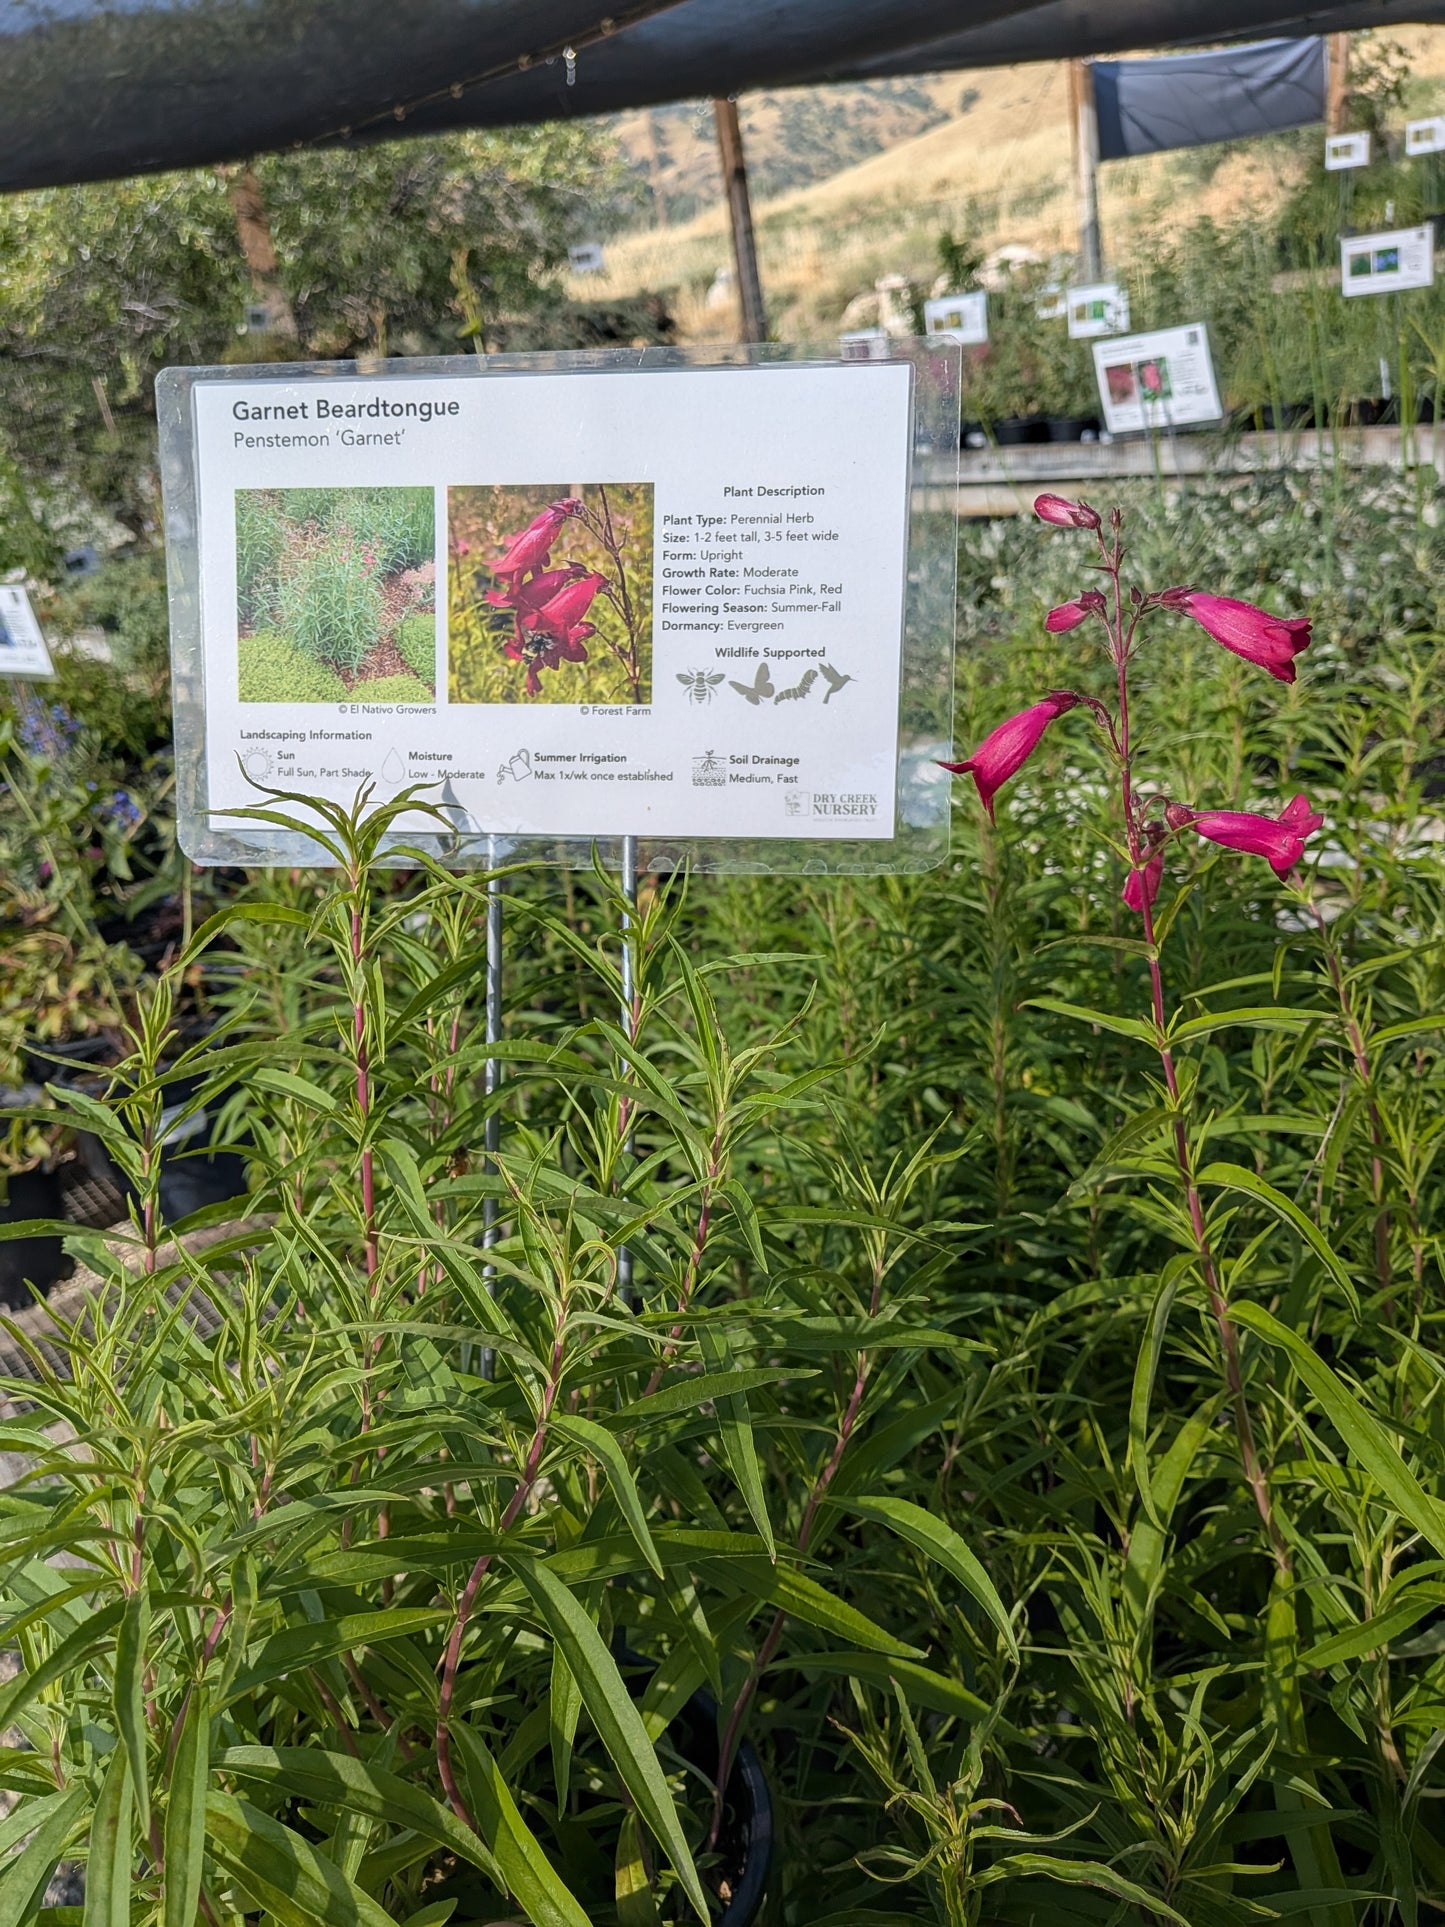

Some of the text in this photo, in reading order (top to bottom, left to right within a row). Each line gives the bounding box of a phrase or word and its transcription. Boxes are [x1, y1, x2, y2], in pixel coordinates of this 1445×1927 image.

[233, 397, 460, 422] Garnet Beardtongue
[234, 432, 329, 448] Penstemon
[724, 485, 825, 498] Plant Description
[663, 512, 814, 527] Plant Type: Perennial Herb
[662, 530, 839, 543] Size: 1-2 feet tall, 3-5 feet wide
[662, 550, 743, 563] Form: Upright
[662, 567, 798, 578] Growth Rate: Moderate
[662, 584, 842, 595] Flower Color: Fuchsia Pink, Red
[662, 601, 841, 615] Flowering Season: Summer-Fall
[662, 620, 784, 633] Dormancy: Evergreen
[715, 647, 825, 660] Wildlife Supported
[350, 705, 359, 714] El
[362, 705, 393, 714] Nativo
[396, 705, 436, 714] Growers
[592, 706, 622, 716] Forest
[626, 706, 651, 715] Farm
[240, 730, 372, 742] Landscaping Information
[277, 751, 295, 760] Sun
[408, 751, 452, 761] Moisture
[534, 753, 626, 764] Summer Irrigation
[729, 755, 799, 767] Soil Drainage
[278, 768, 371, 778] Full Sun, Part Shade
[408, 770, 428, 778] Low
[437, 770, 485, 779] Moderate
[534, 771, 555, 780] Max
[560, 771, 587, 780] 1x/wk
[617, 771, 673, 781] established
[729, 774, 798, 784] Medium, Fast
[813, 794, 877, 803] DRY CREEK
[813, 804, 877, 815] NURSERY
